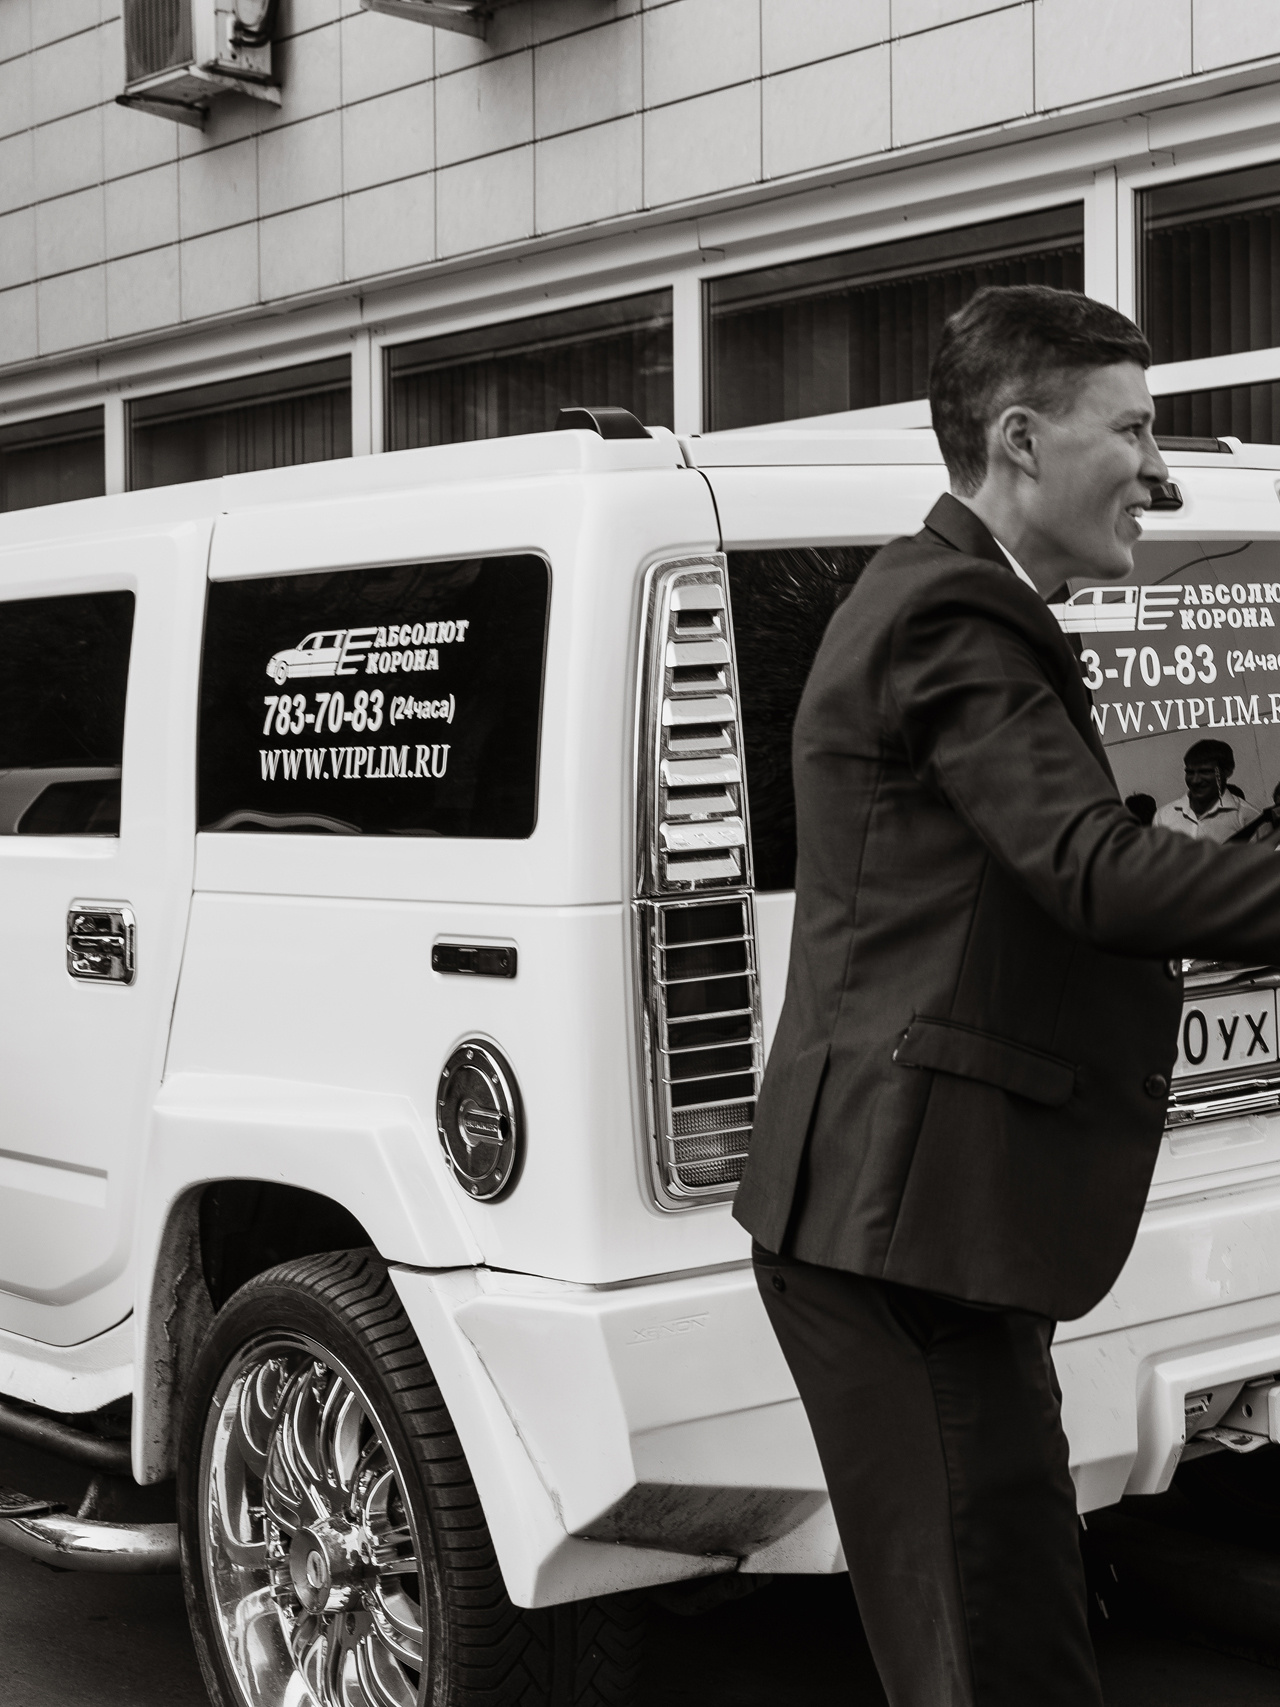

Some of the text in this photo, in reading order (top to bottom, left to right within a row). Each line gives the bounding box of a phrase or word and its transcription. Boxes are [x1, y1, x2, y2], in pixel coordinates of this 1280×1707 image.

[373, 619, 470, 648] АБСОЛЮТ
[1179, 606, 1275, 631] КОРОНА
[364, 649, 439, 675] КОРОНА
[1079, 644, 1217, 690] 3-70-83
[262, 689, 456, 736] 783-70-83 (24часа)
[259, 744, 451, 781] WWW.VIPLIM.RU
